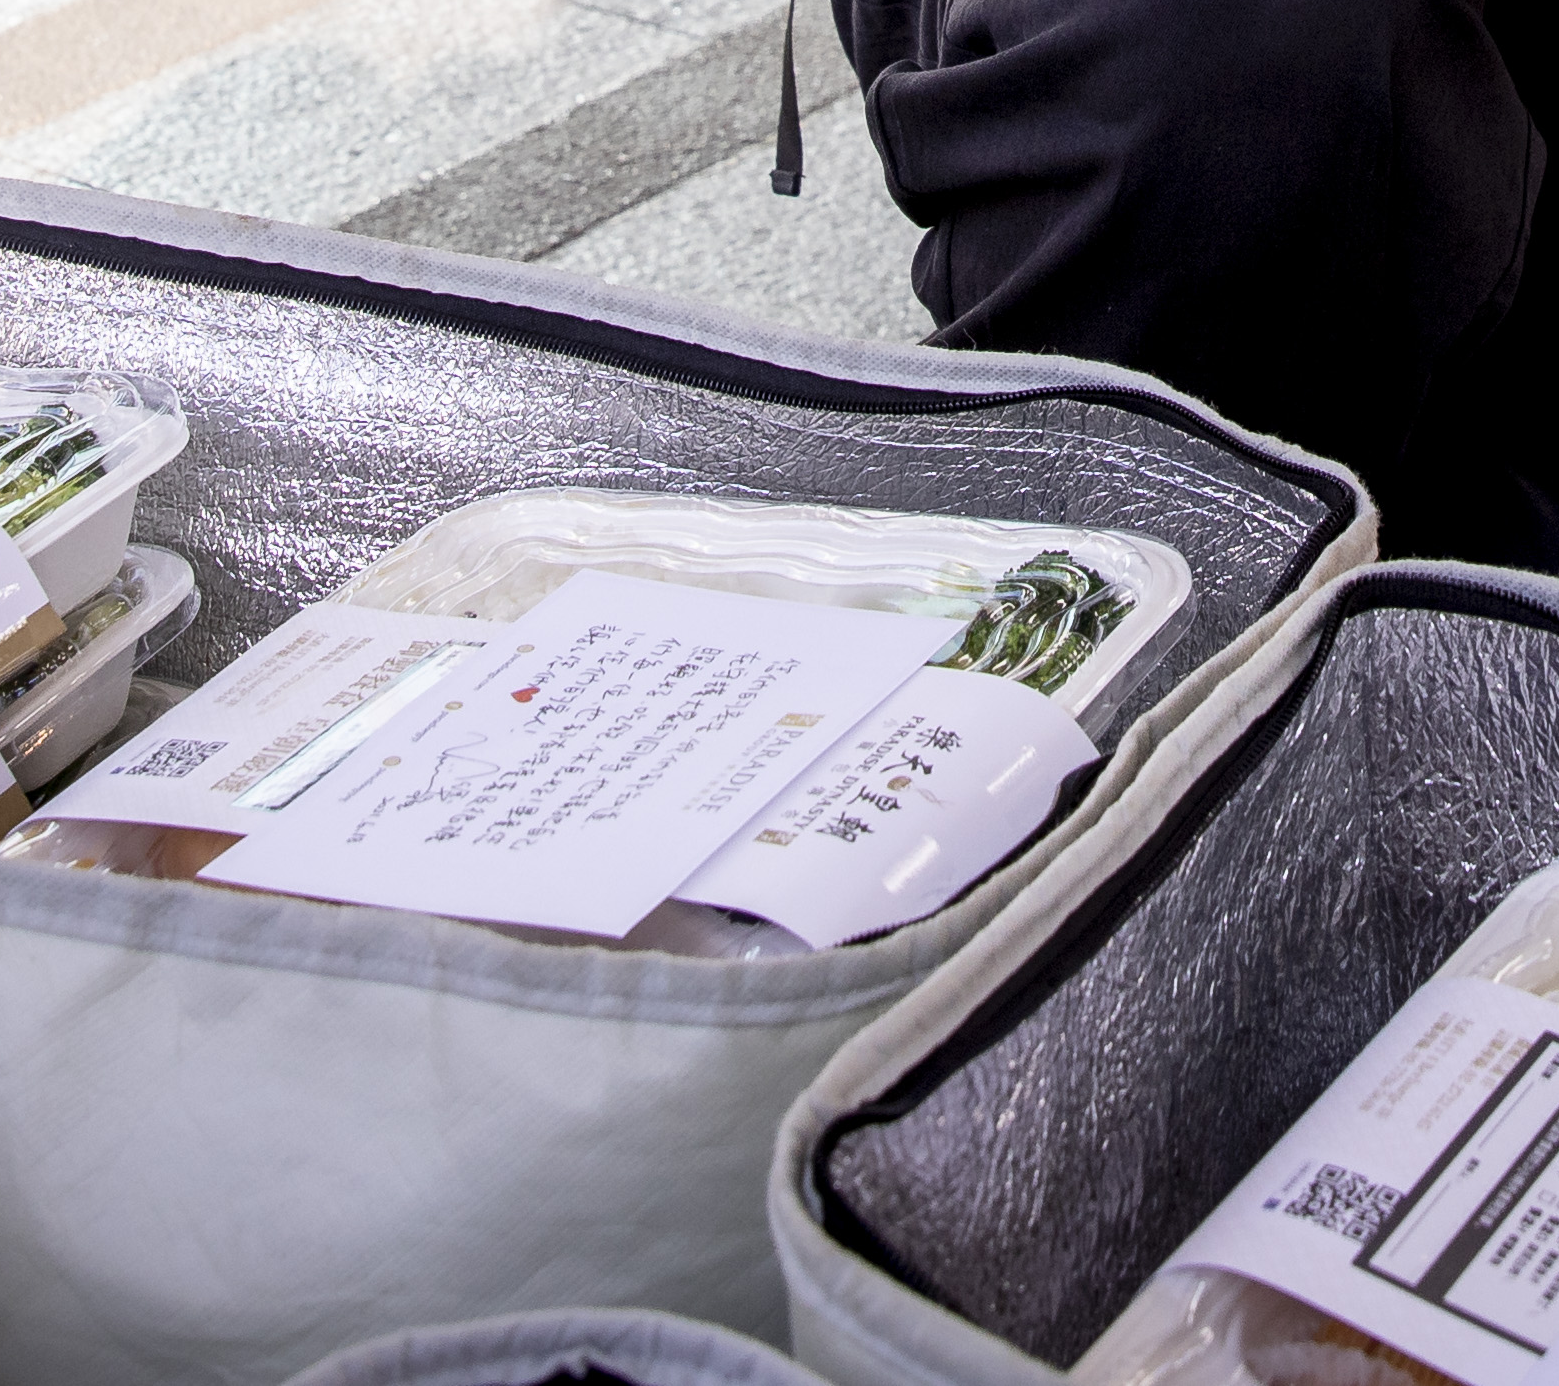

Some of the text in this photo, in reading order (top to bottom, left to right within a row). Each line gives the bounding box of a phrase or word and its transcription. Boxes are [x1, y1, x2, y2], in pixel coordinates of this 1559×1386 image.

[697, 729, 805, 813] PARADISE
[855, 715, 926, 772] PARADISE
[793, 775, 860, 830] DYNASTY
[816, 726, 961, 843] 樂天皇朝
